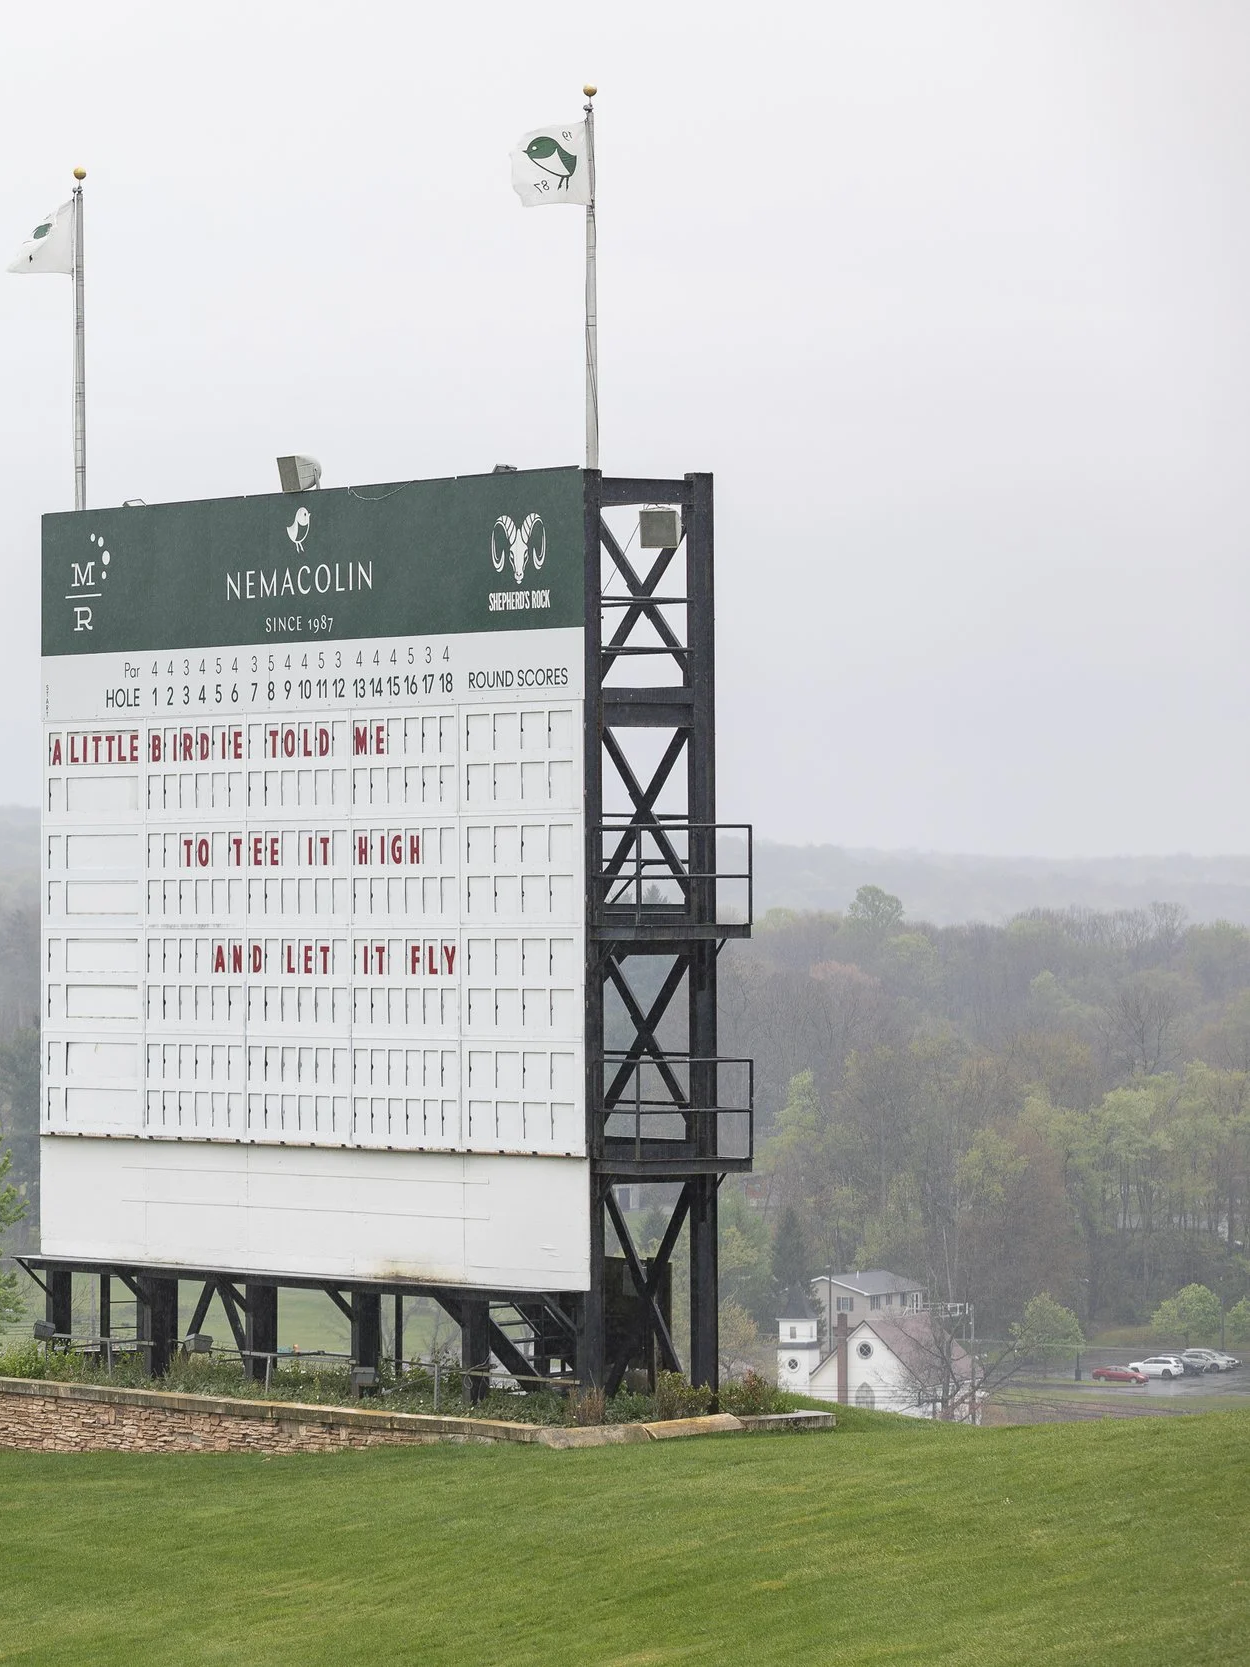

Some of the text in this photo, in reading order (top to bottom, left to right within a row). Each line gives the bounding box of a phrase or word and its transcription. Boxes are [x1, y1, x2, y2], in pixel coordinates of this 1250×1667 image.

[71, 562, 95, 587] M
[226, 562, 374, 600] NEMACOLIN
[488, 590, 551, 612] SHEPHERD'S ROCK
[74, 607, 93, 632] R
[265, 615, 334, 634] SINCE 1987
[124, 646, 450, 679] Par 4 4 3 4 5 4 3 5 4 4 5 3 4 4 4 5 3 4
[106, 672, 454, 708] HOLE 1 2 3 4 5 6 7 8 9 10 11 12 13 14 15 16 17 18
[469, 668, 569, 689] ROUND SCORES
[53, 725, 385, 766] A LITTLE BIRDIE TOLD ME
[184, 835, 420, 867] TO TEE IT HIGH
[215, 945, 456, 975] AND LET IT FLY
